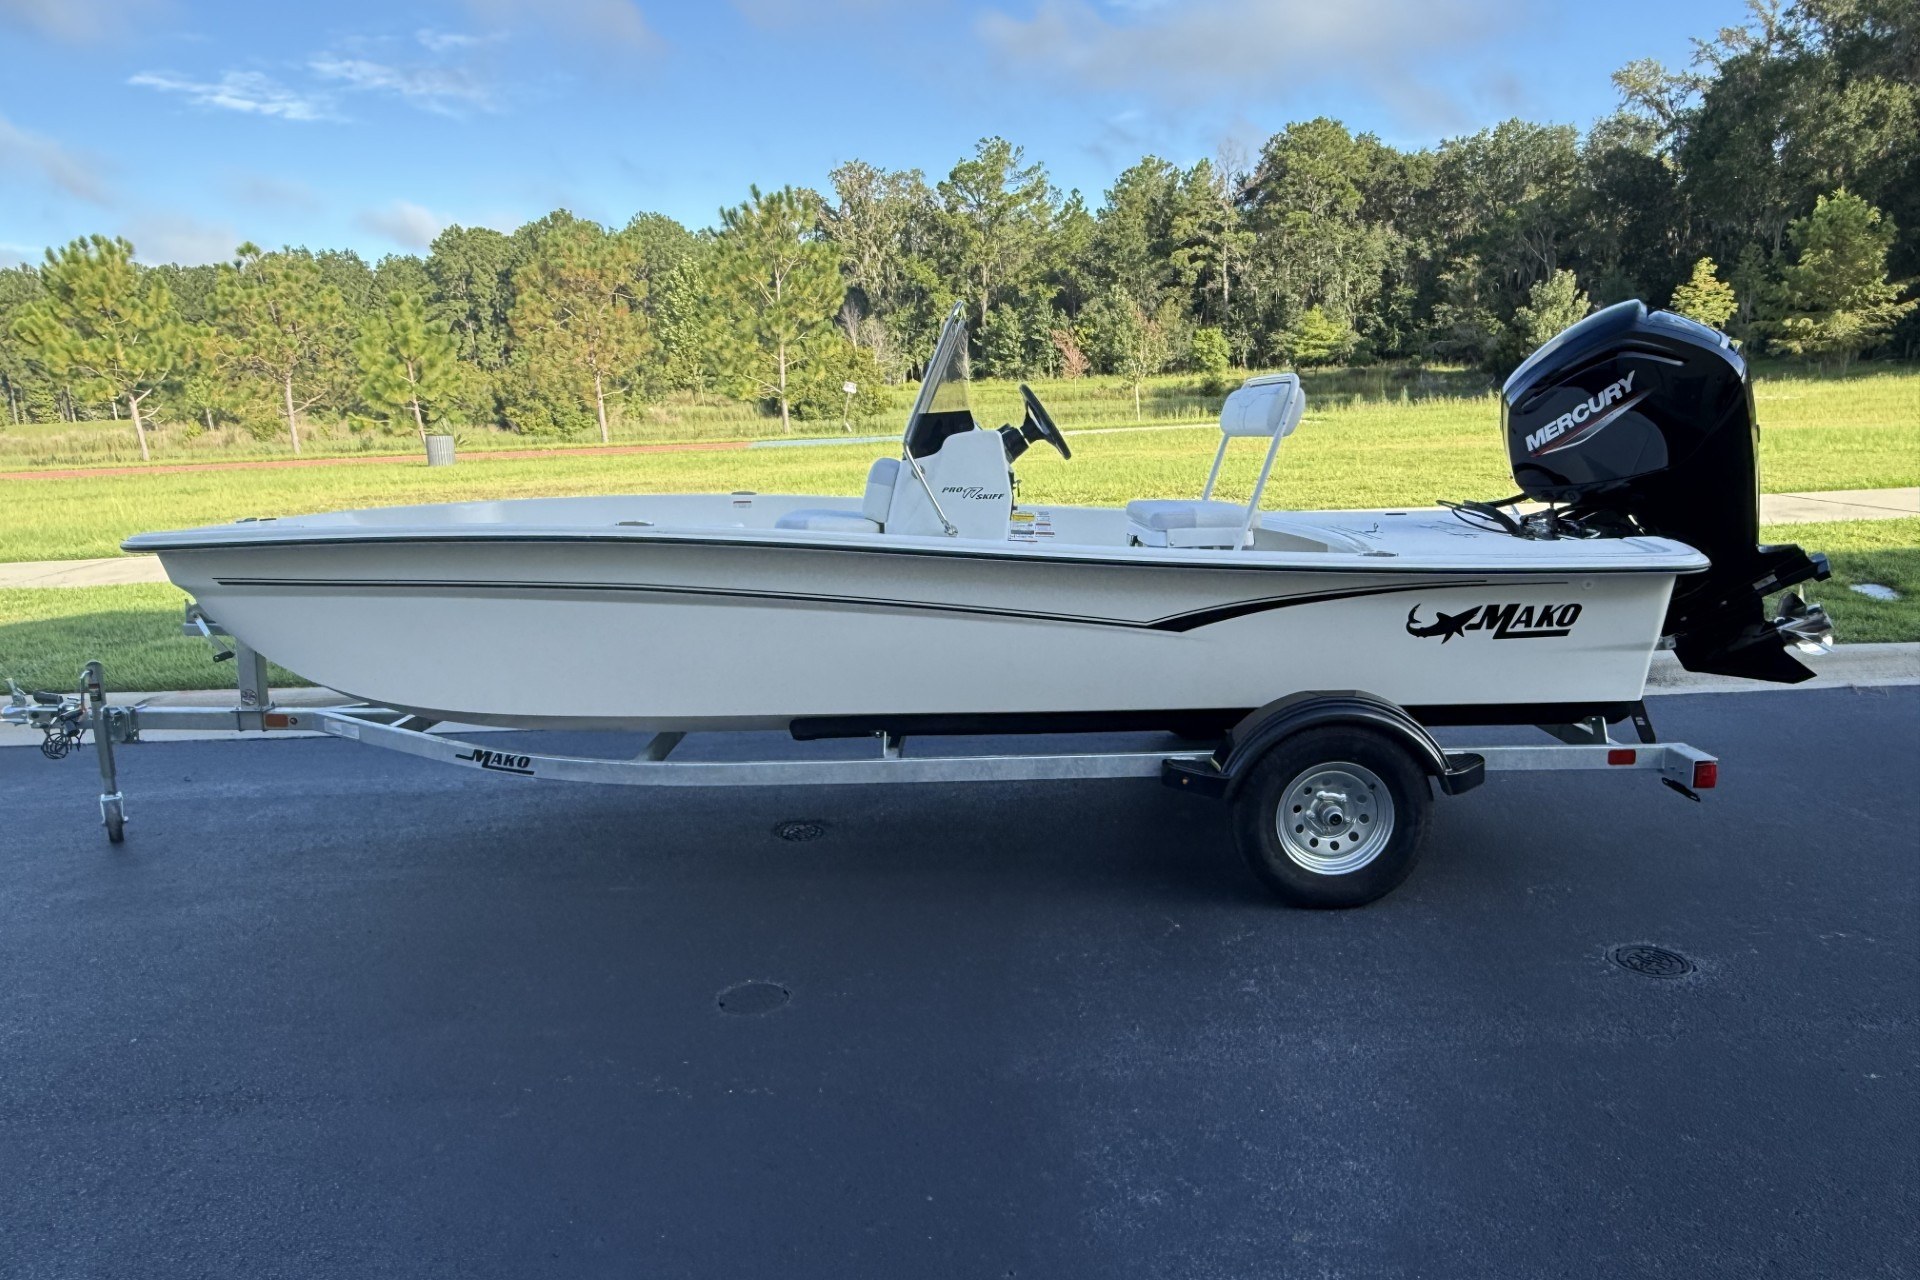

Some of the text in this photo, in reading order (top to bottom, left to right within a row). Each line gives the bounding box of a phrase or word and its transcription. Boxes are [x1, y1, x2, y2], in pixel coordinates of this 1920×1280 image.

[1525, 370, 1635, 452] MERCURY
[1464, 603, 1583, 639] MAKO
[455, 749, 535, 775] MAKO
